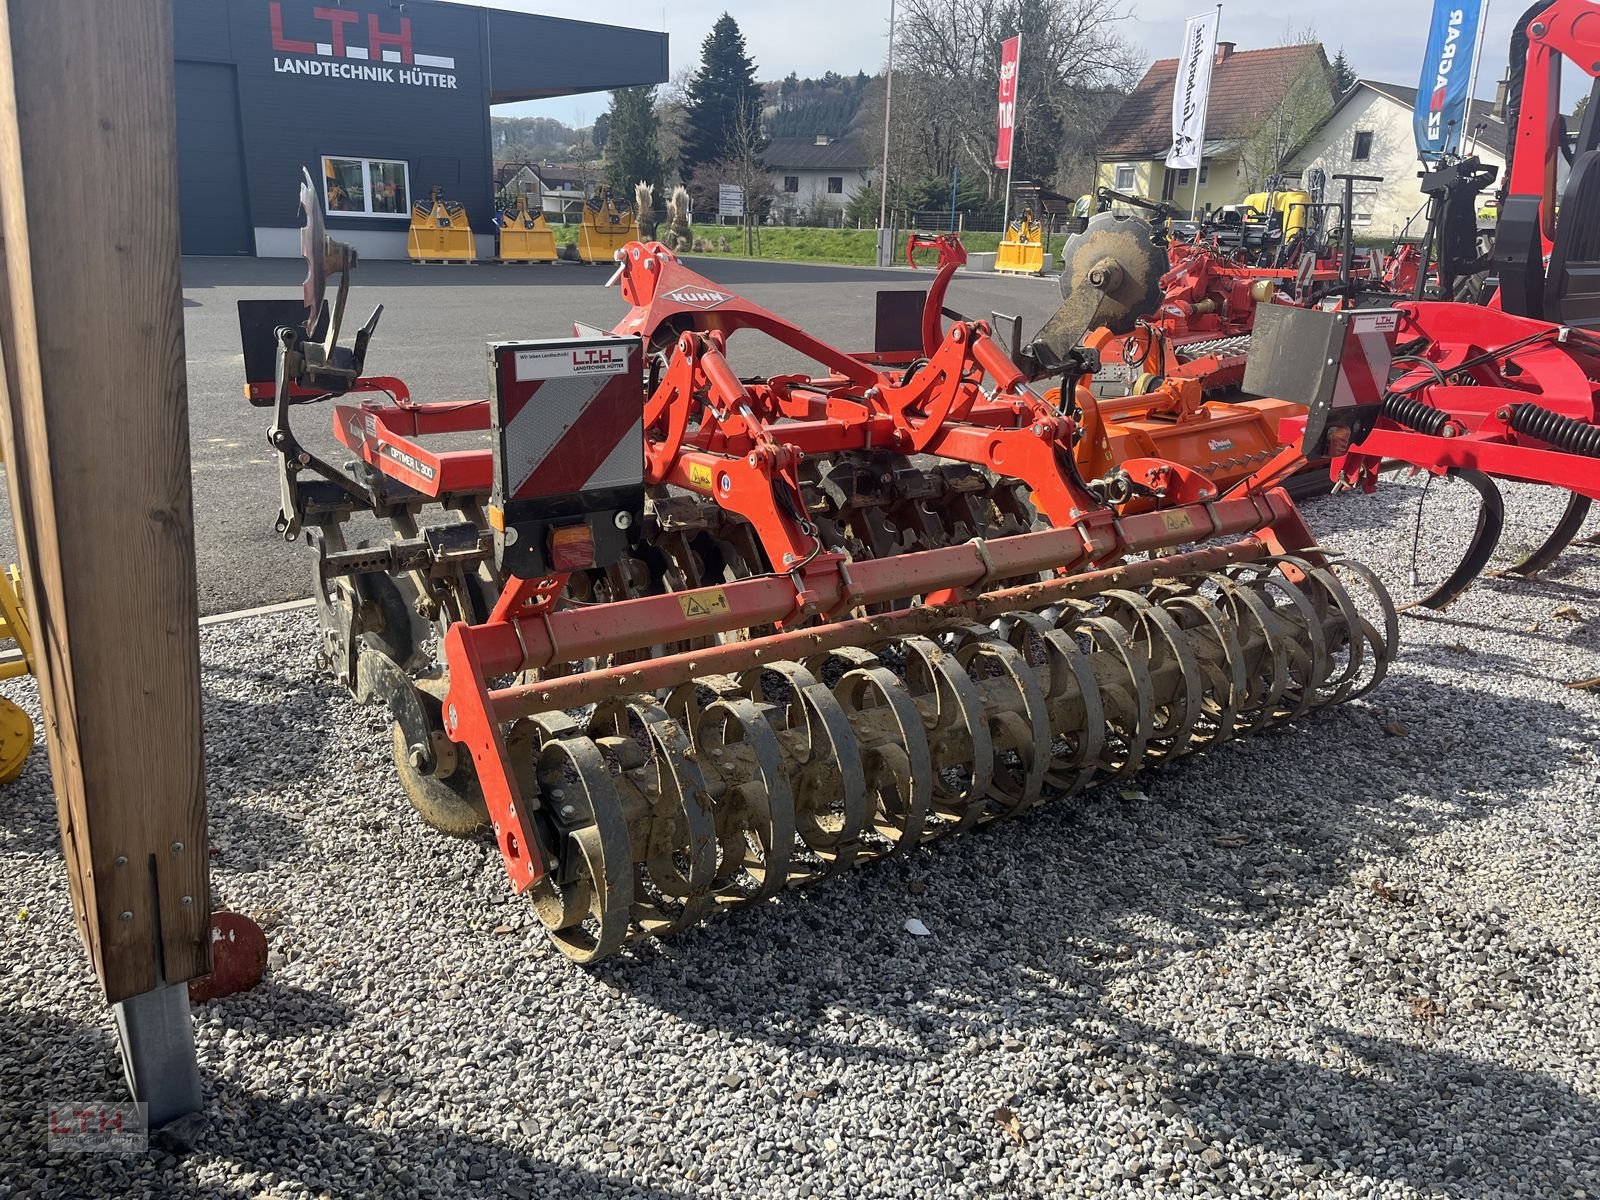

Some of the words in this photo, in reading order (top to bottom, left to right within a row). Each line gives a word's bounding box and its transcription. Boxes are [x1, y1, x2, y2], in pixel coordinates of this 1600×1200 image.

[273, 57, 395, 83] LANDTECHNIK
[399, 67, 458, 89] HÜTTER
[671, 292, 724, 302] KUHN
[573, 363, 606, 371] LANDTECHNIK
[390, 446, 415, 469] OPTIMER
[415, 460, 420, 472] L
[420, 463, 433, 479] 300
